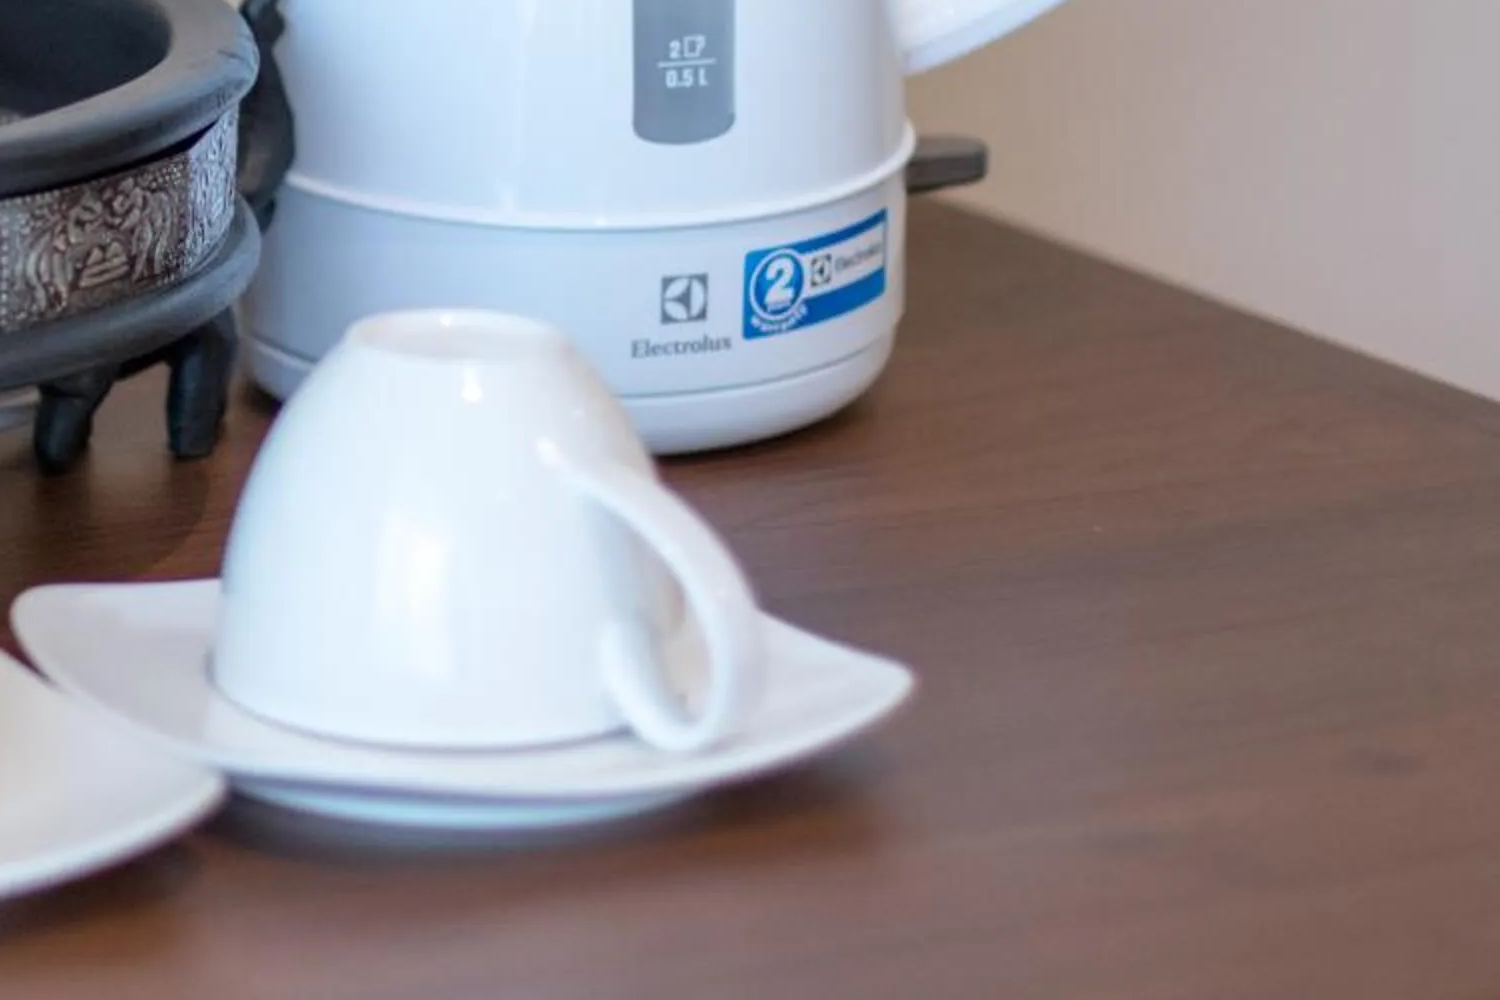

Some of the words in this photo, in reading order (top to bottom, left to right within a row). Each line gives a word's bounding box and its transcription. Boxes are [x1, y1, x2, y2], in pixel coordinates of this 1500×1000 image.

[669, 39, 681, 59] 2
[665, 69, 694, 88] 0.5
[765, 257, 796, 305] 2
[630, 335, 732, 359] Electrolux
